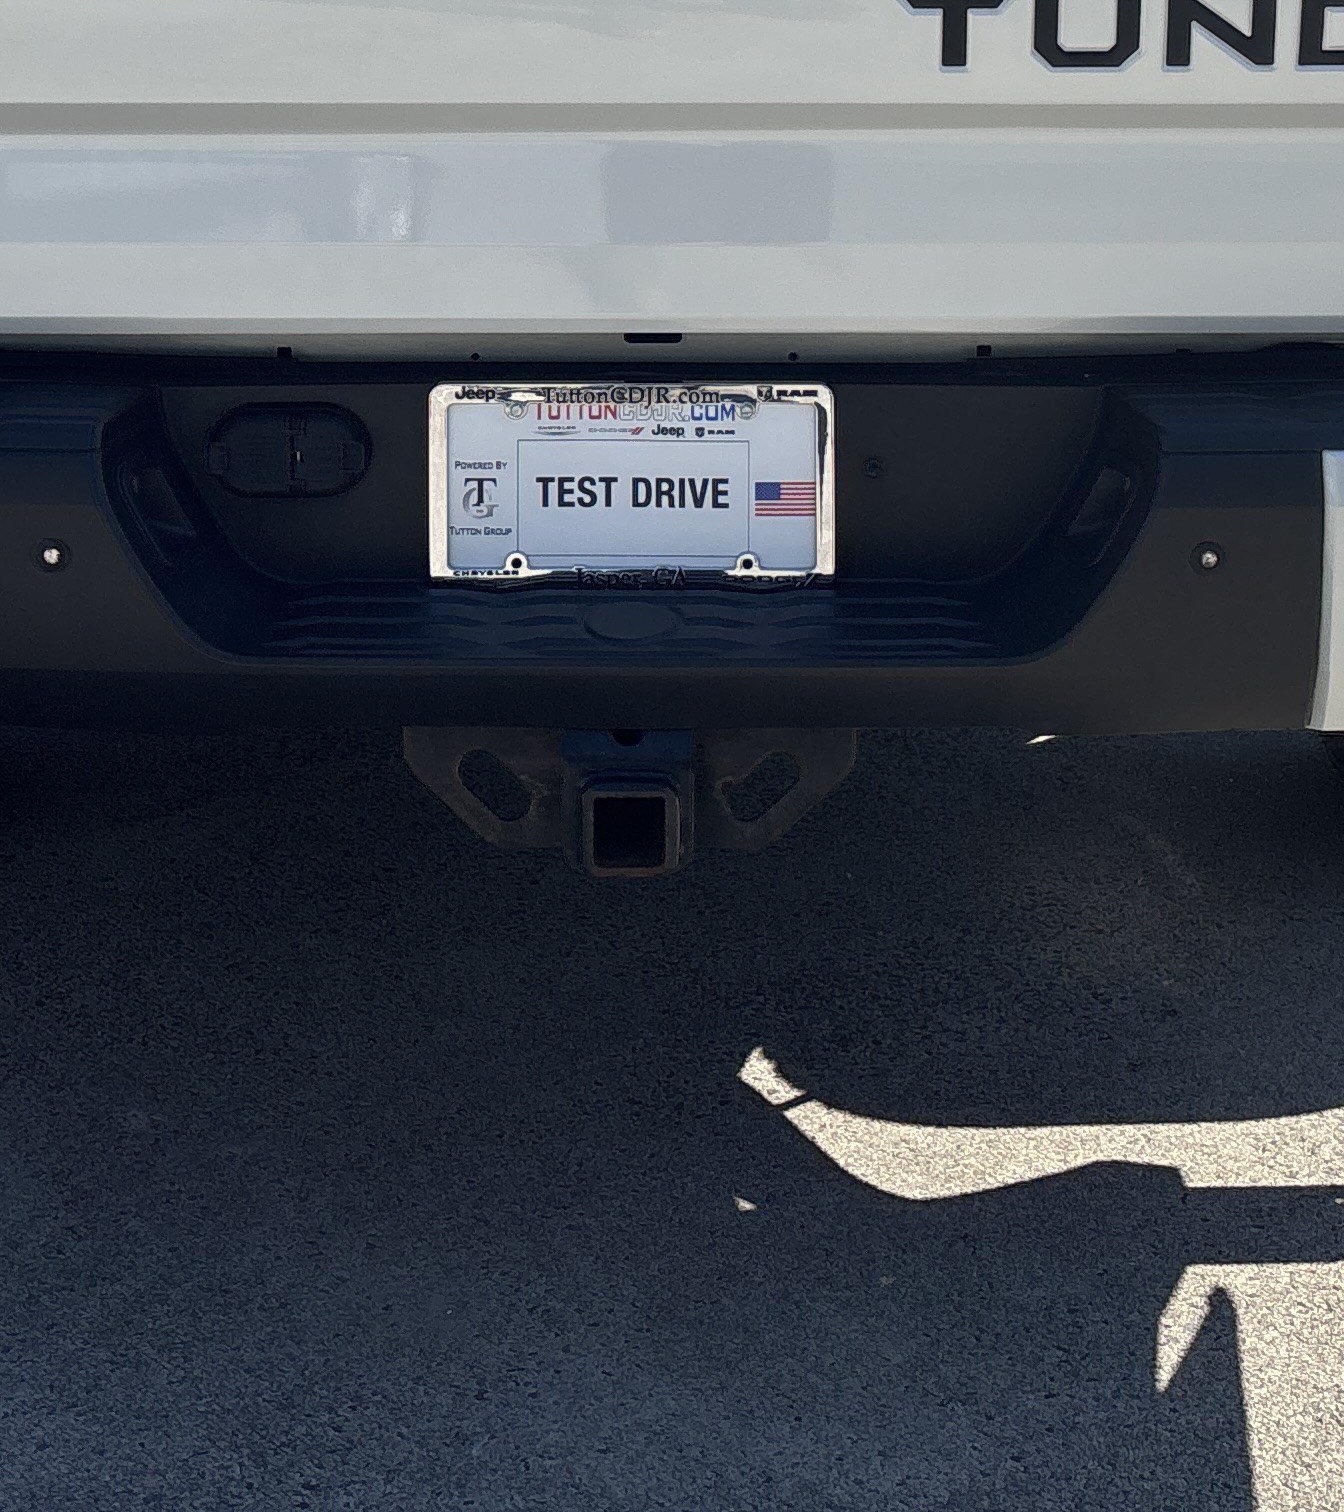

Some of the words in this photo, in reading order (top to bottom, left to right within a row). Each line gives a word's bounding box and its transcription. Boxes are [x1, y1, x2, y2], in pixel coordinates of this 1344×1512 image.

[455, 386, 495, 402] Jeep
[542, 386, 720, 408] TuttonCDJR.com
[535, 403, 736, 422] TUTTONCDJR.COM
[651, 424, 685, 438] Jeep
[536, 476, 618, 508] TEST
[632, 477, 730, 509] DRIVE
[653, 566, 687, 586] GA
